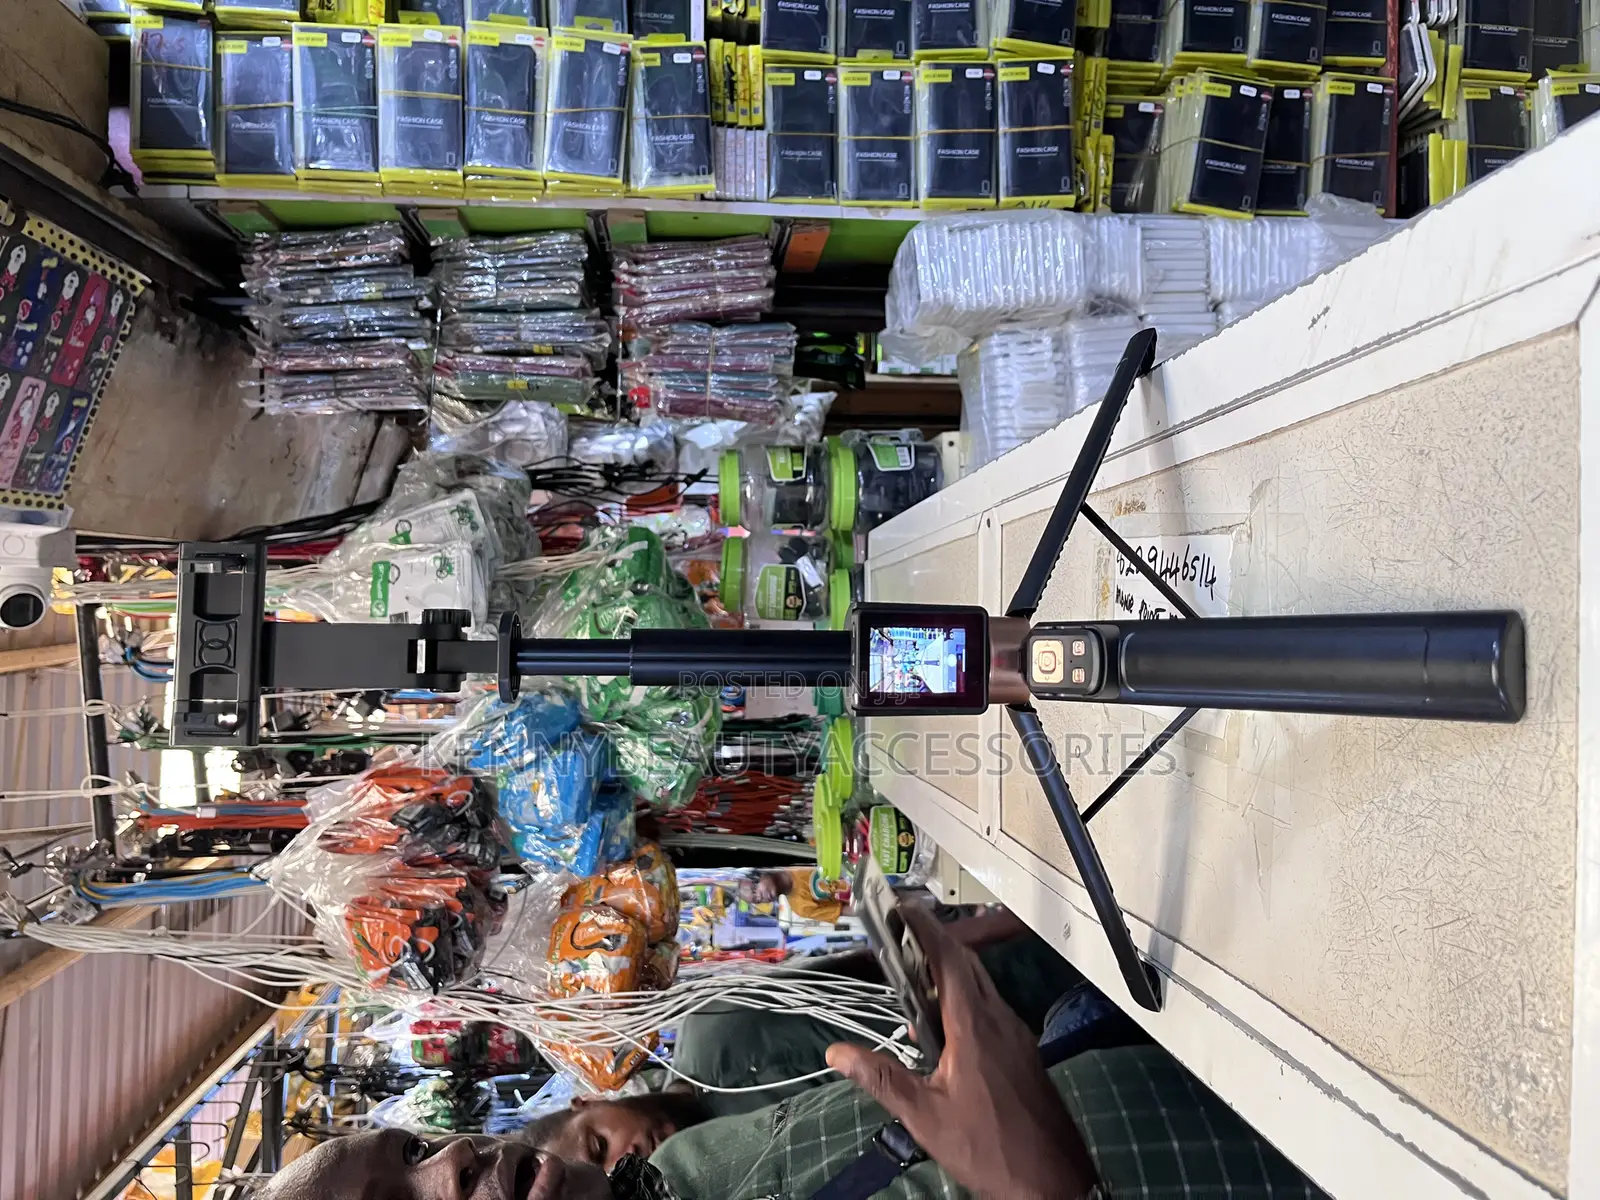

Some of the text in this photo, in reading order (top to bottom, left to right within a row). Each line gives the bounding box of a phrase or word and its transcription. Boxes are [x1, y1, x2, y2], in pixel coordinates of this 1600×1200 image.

[777, 0, 804, 9] FASHION
[928, 1, 955, 9] FASHION
[1271, 13, 1312, 23] FASHION CASE
[396, 116, 444, 125] FASHION CASE
[481, 115, 527, 125] FASHION CASE
[651, 133, 696, 142] FASHION CASE
[1205, 159, 1247, 171] FASHION CASE
